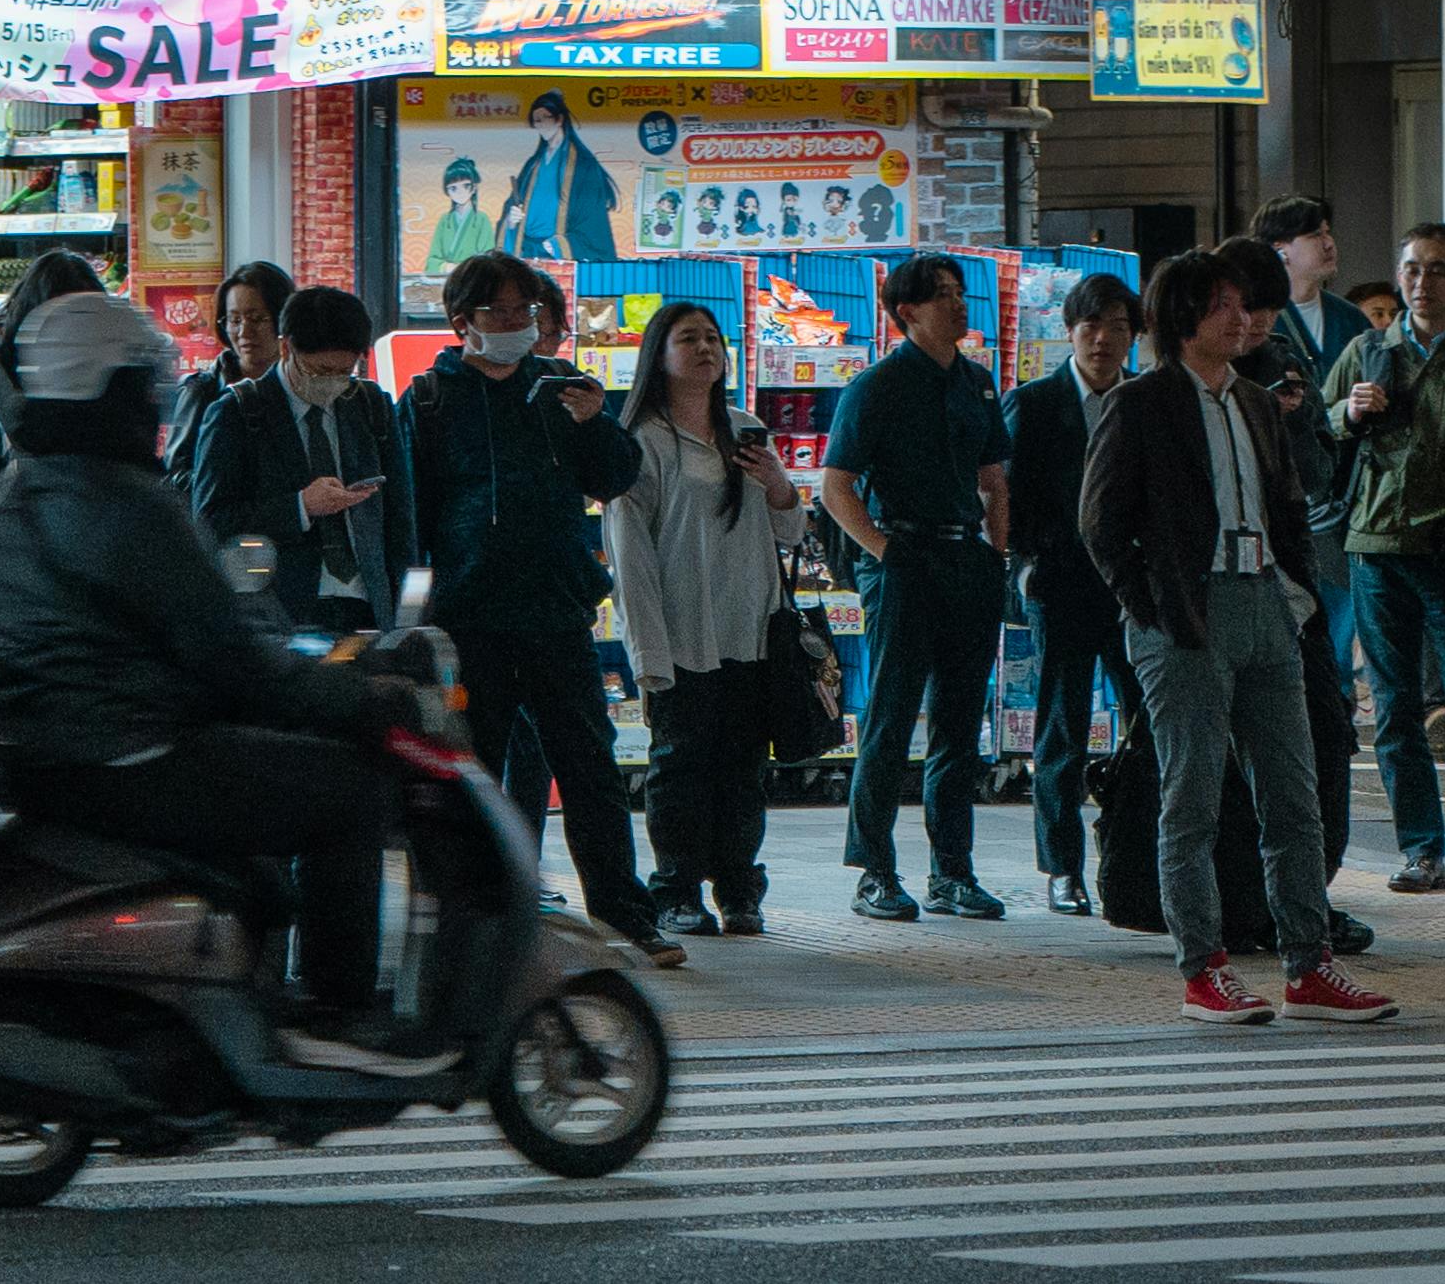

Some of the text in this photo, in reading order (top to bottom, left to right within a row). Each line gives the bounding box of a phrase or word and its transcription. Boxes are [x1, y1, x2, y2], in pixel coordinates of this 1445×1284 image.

[794, 32, 877, 48] ヒロインメイク
[910, 32, 981, 53] KATE
[83, 13, 280, 89] SALE
[554, 45, 721, 65] TAX FREE
[587, 86, 620, 107] GP
[690, 137, 802, 160] アクリルスタンド
[162, 150, 200, 172] 抹茶
